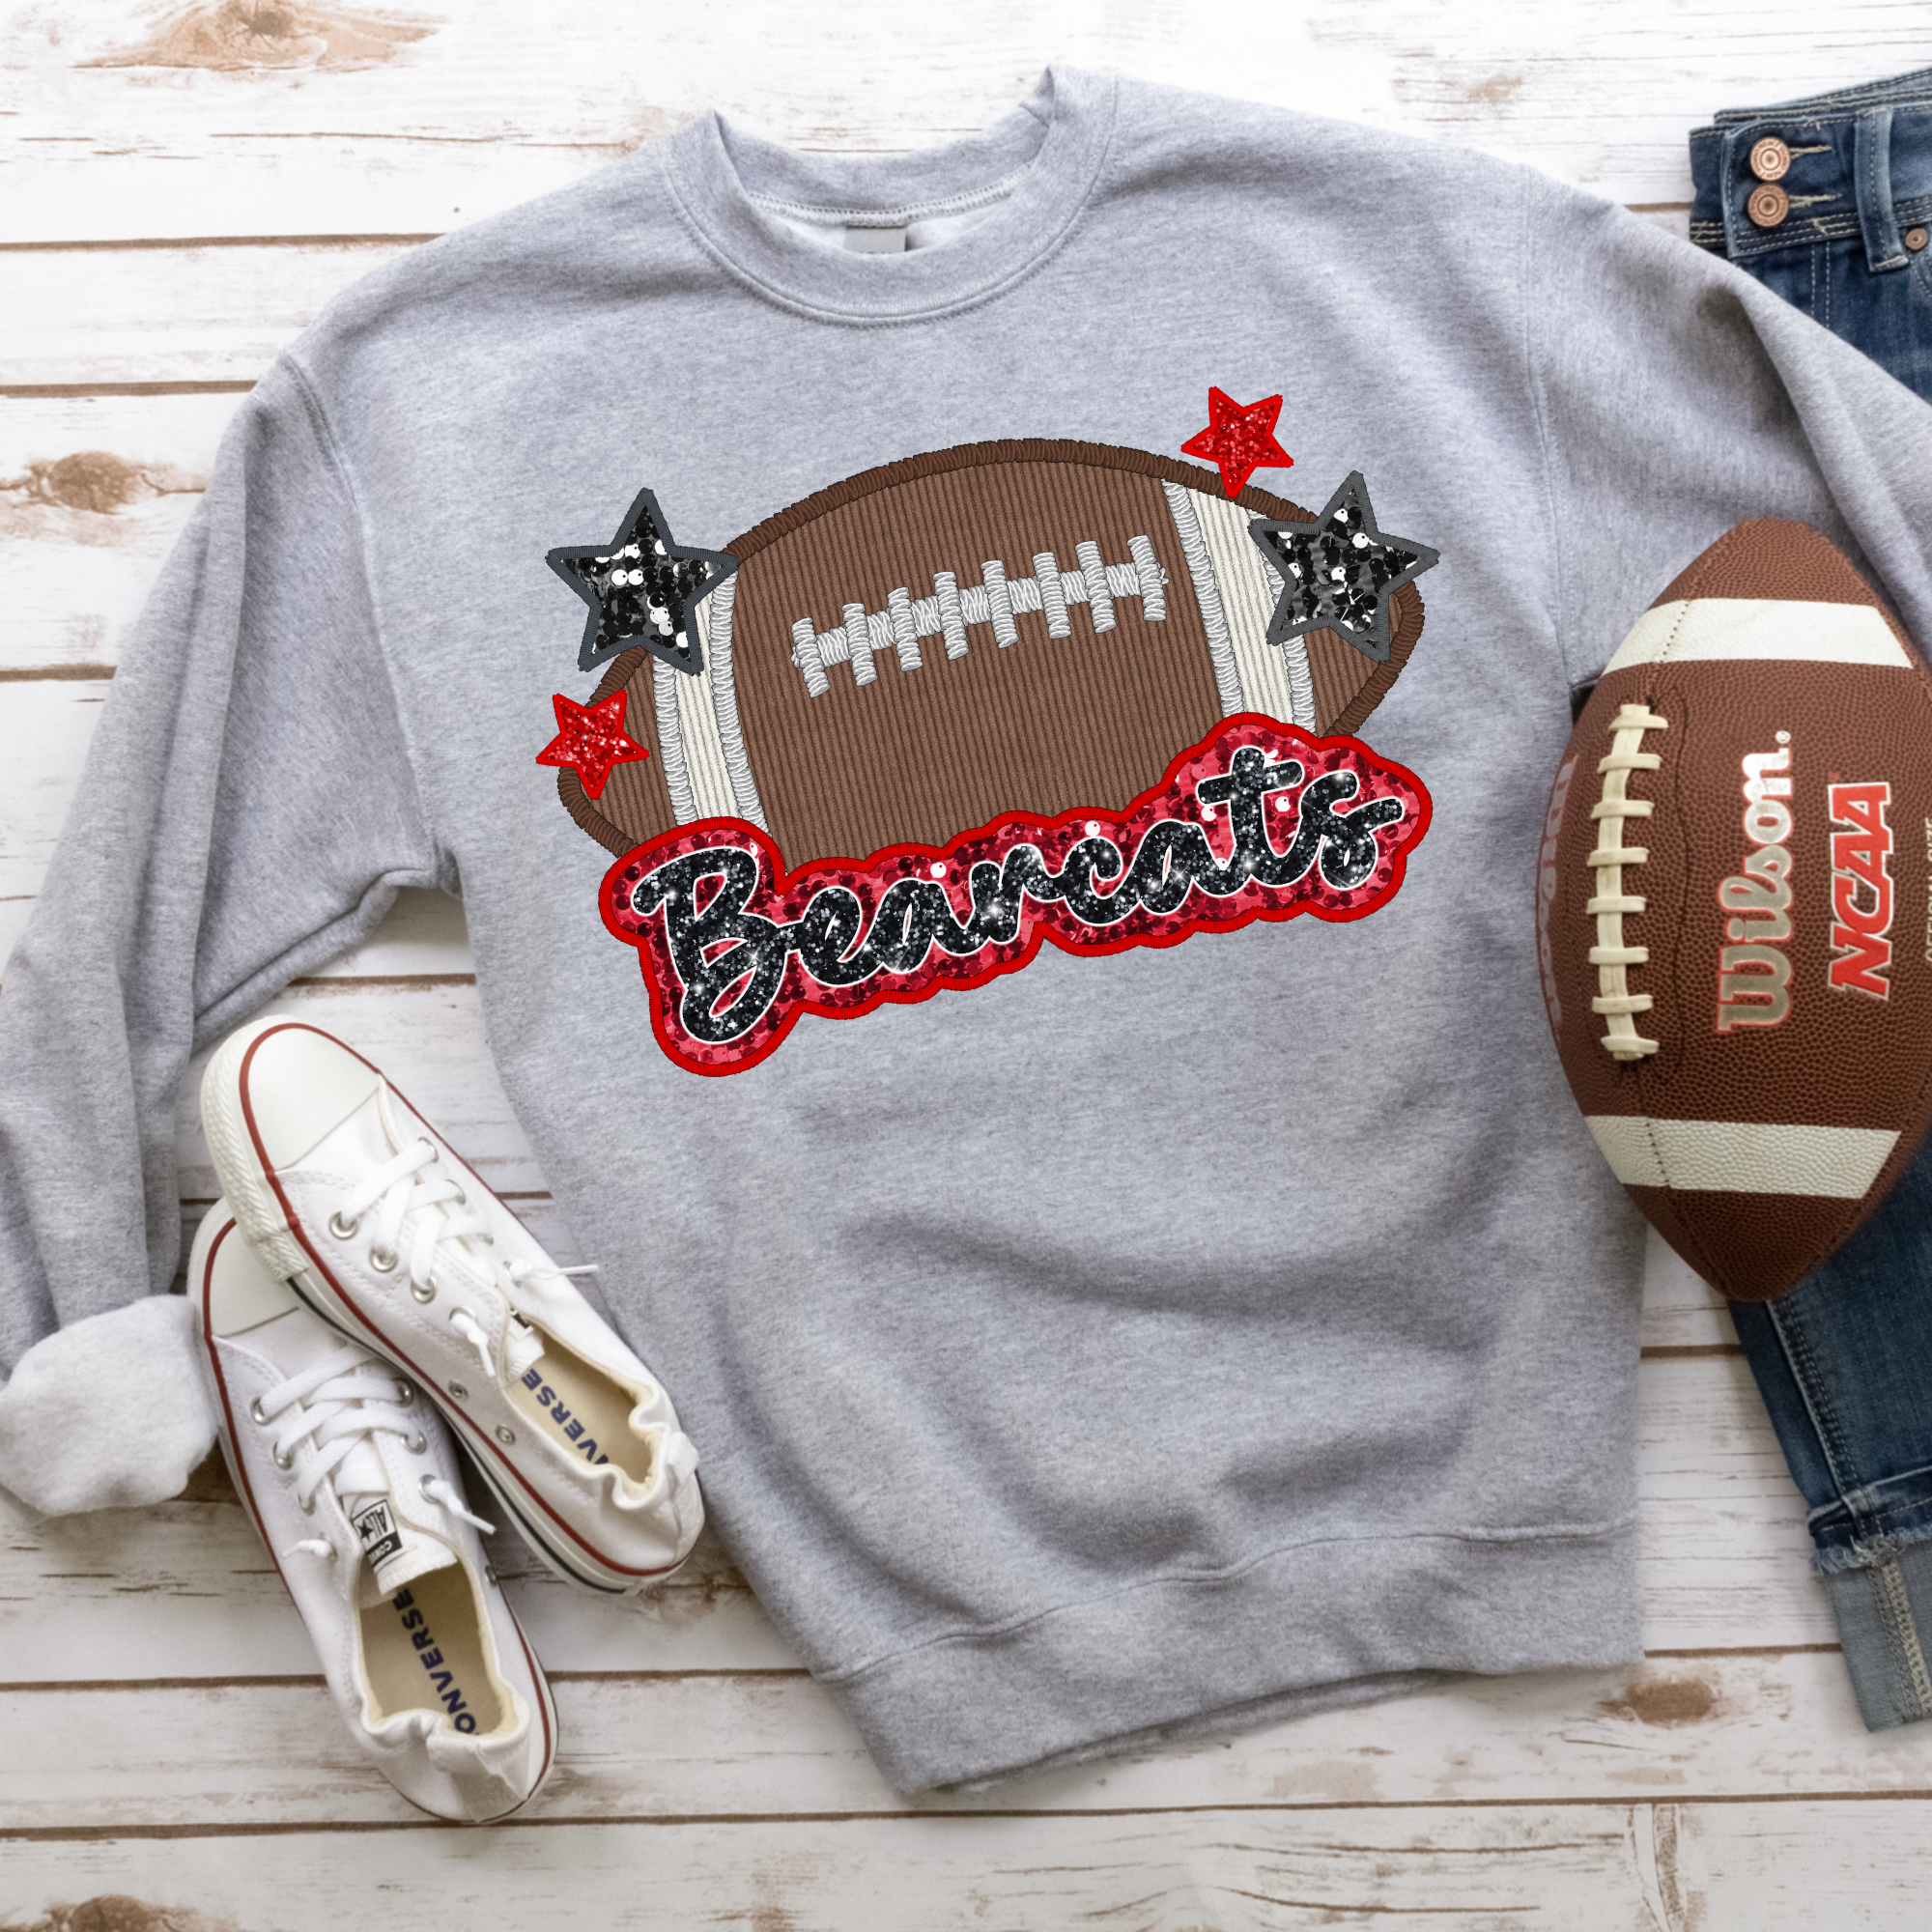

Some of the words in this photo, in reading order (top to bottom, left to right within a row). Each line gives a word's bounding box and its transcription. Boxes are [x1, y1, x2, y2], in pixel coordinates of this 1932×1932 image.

[631, 745, 1404, 1043] Bearcats
[1828, 781, 1893, 1001] NCAA
[392, 1588, 476, 1734] ONVERSE
